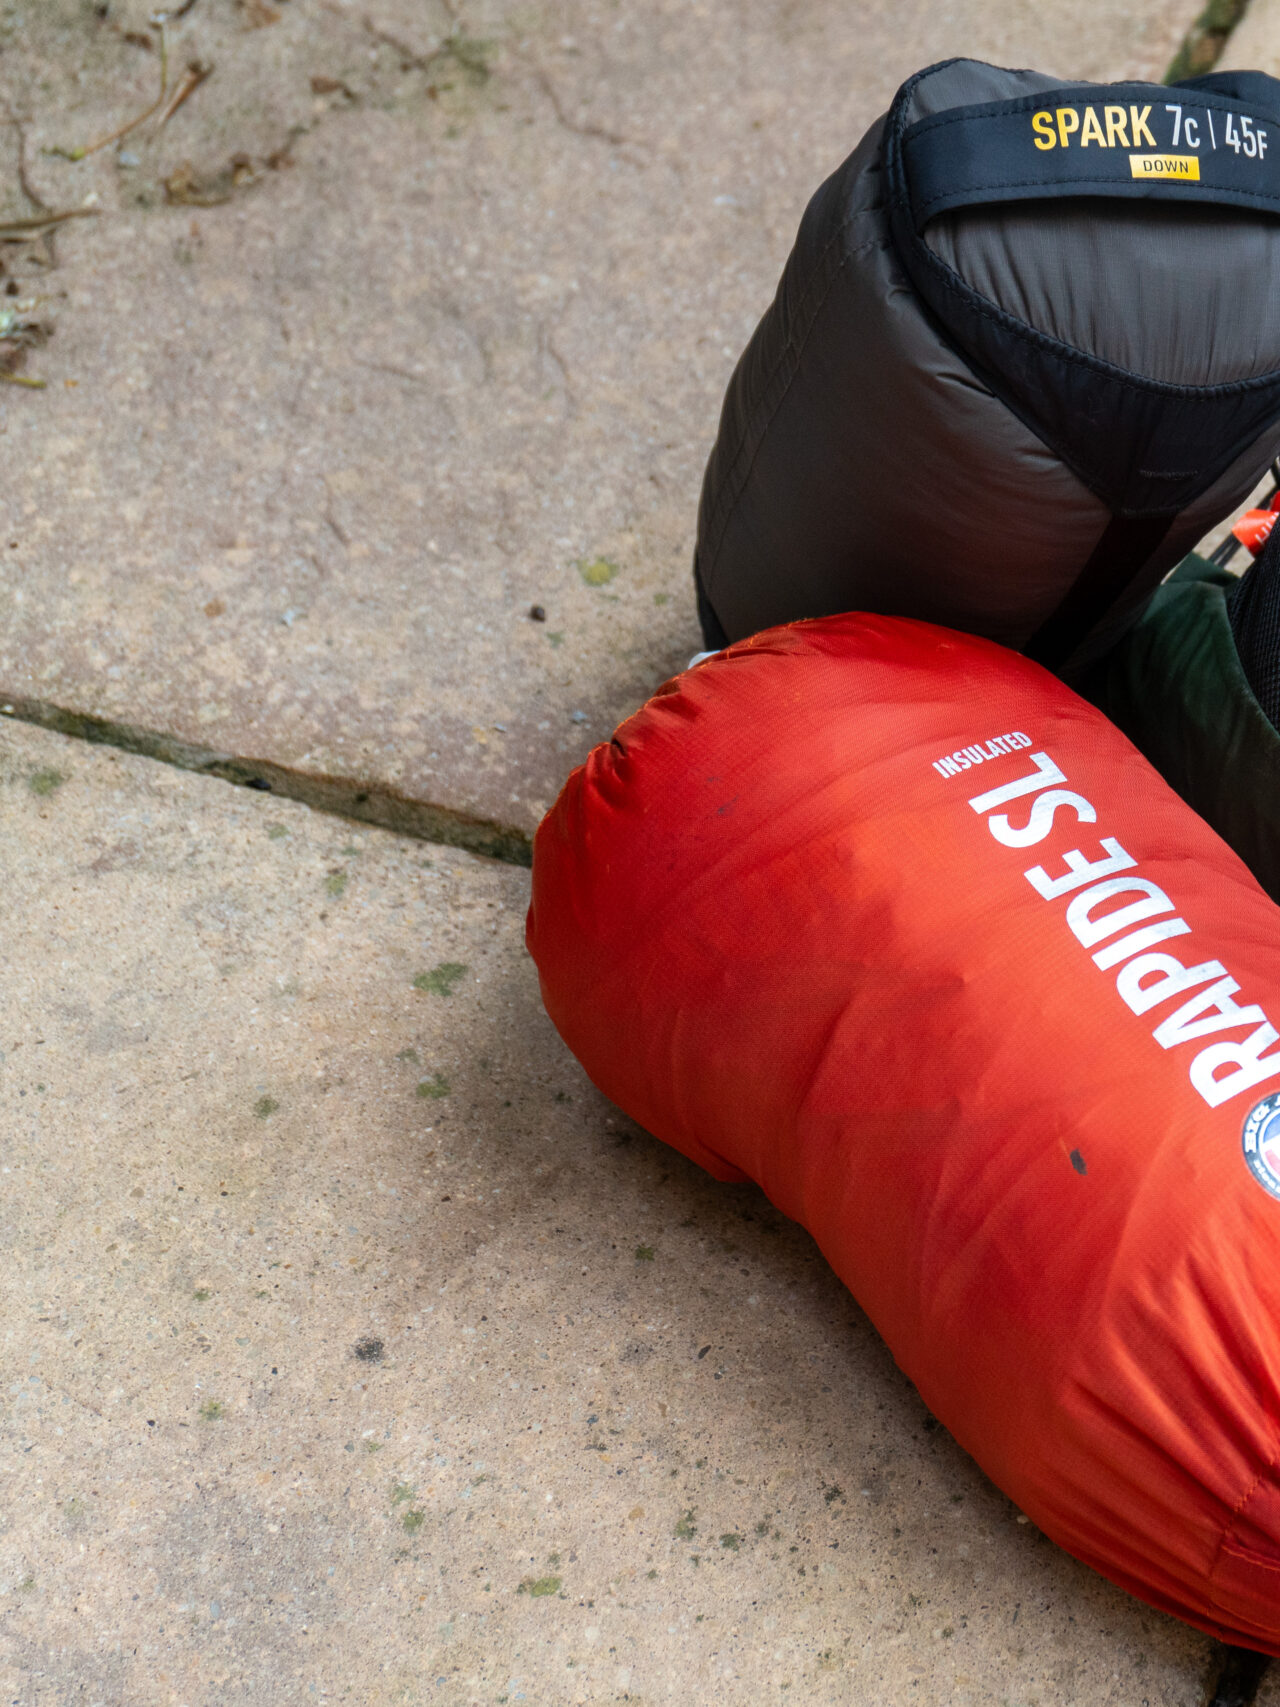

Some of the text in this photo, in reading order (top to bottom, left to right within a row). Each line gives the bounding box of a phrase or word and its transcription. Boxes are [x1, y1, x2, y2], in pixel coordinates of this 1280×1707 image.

[1031, 105, 1157, 150] SPARK
[1225, 112, 1268, 159] 45F
[1143, 160, 1189, 173] DOWN
[932, 731, 1033, 779] INSULATED
[967, 751, 1097, 849] SL
[1244, 1103, 1271, 1153] BIG
